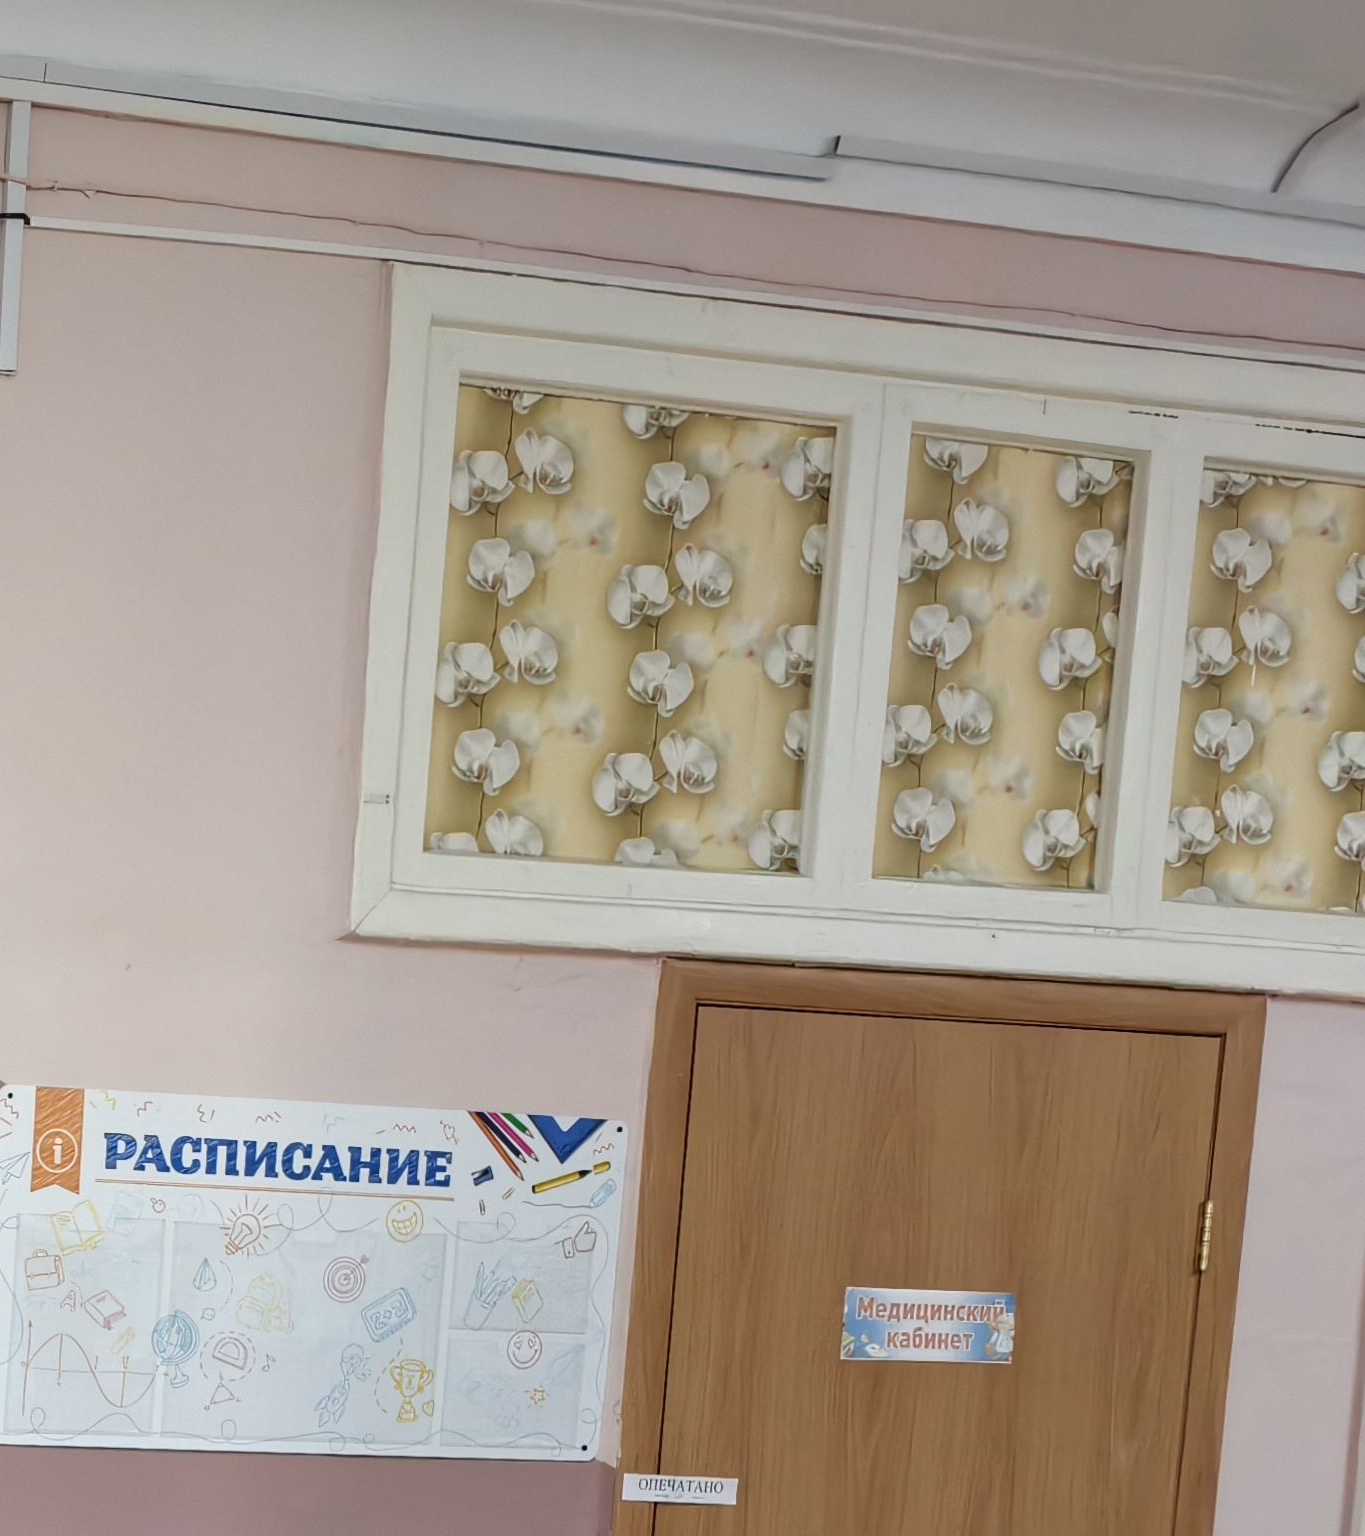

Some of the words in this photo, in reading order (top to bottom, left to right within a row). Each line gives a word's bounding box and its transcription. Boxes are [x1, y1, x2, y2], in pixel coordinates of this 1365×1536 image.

[103, 1132, 454, 1188] РАСПИСАНИЕ
[856, 1296, 1006, 1324] Медицинский
[886, 1327, 974, 1350] кабинет
[638, 1478, 724, 1494] ОПЕЧАТАНО
